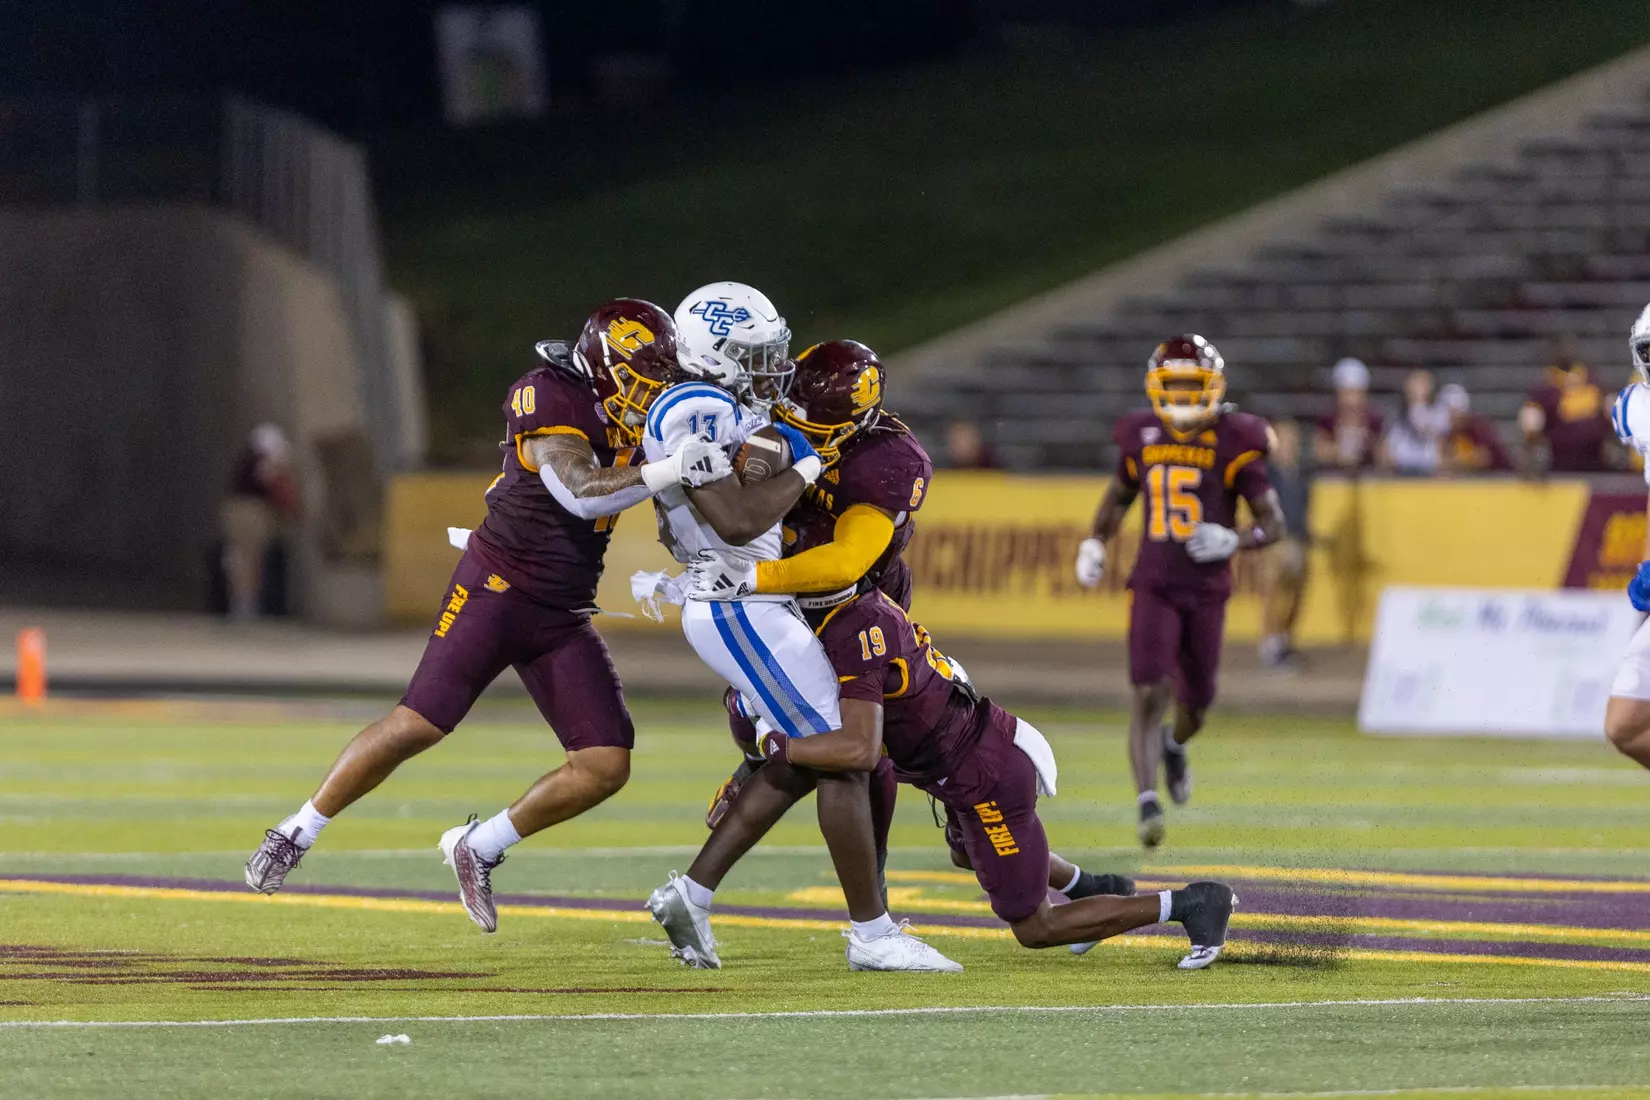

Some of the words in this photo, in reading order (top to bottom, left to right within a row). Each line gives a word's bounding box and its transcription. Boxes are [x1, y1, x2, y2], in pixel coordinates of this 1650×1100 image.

[511, 385, 536, 417] 40
[687, 411, 719, 442] 13
[909, 477, 925, 507] 6
[1147, 464, 1204, 542] 15
[858, 625, 887, 661] 19
[973, 800, 1004, 823] UP!
[983, 823, 1020, 857] FIRE
